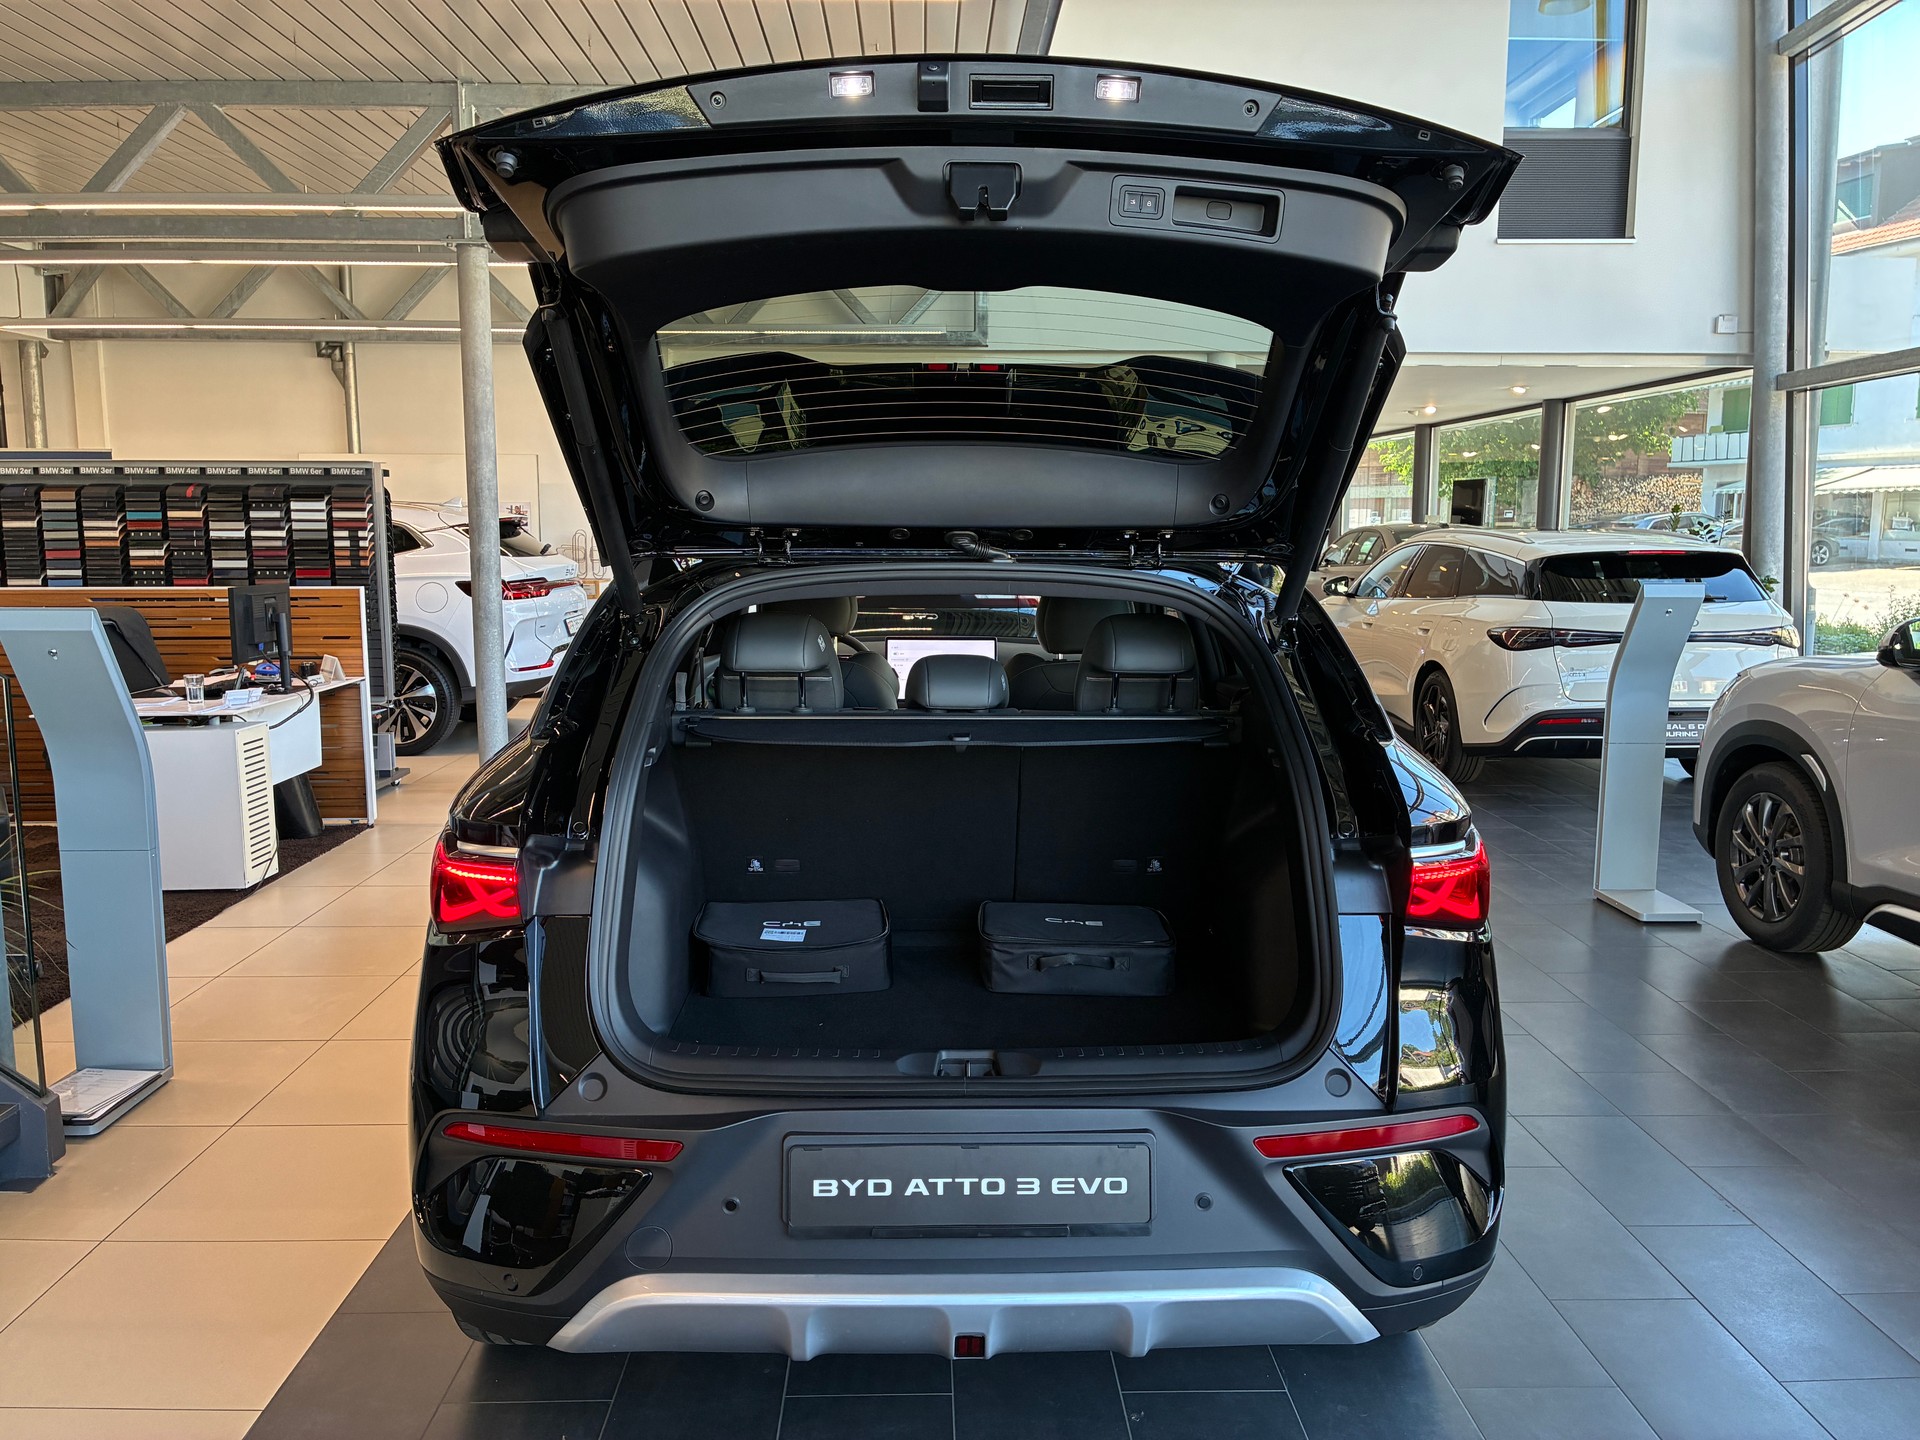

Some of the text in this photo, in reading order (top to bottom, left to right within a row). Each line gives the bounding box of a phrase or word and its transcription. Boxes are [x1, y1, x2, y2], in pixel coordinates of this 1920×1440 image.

[813, 1177, 1128, 1197] BYD ATTO 3 EVO
